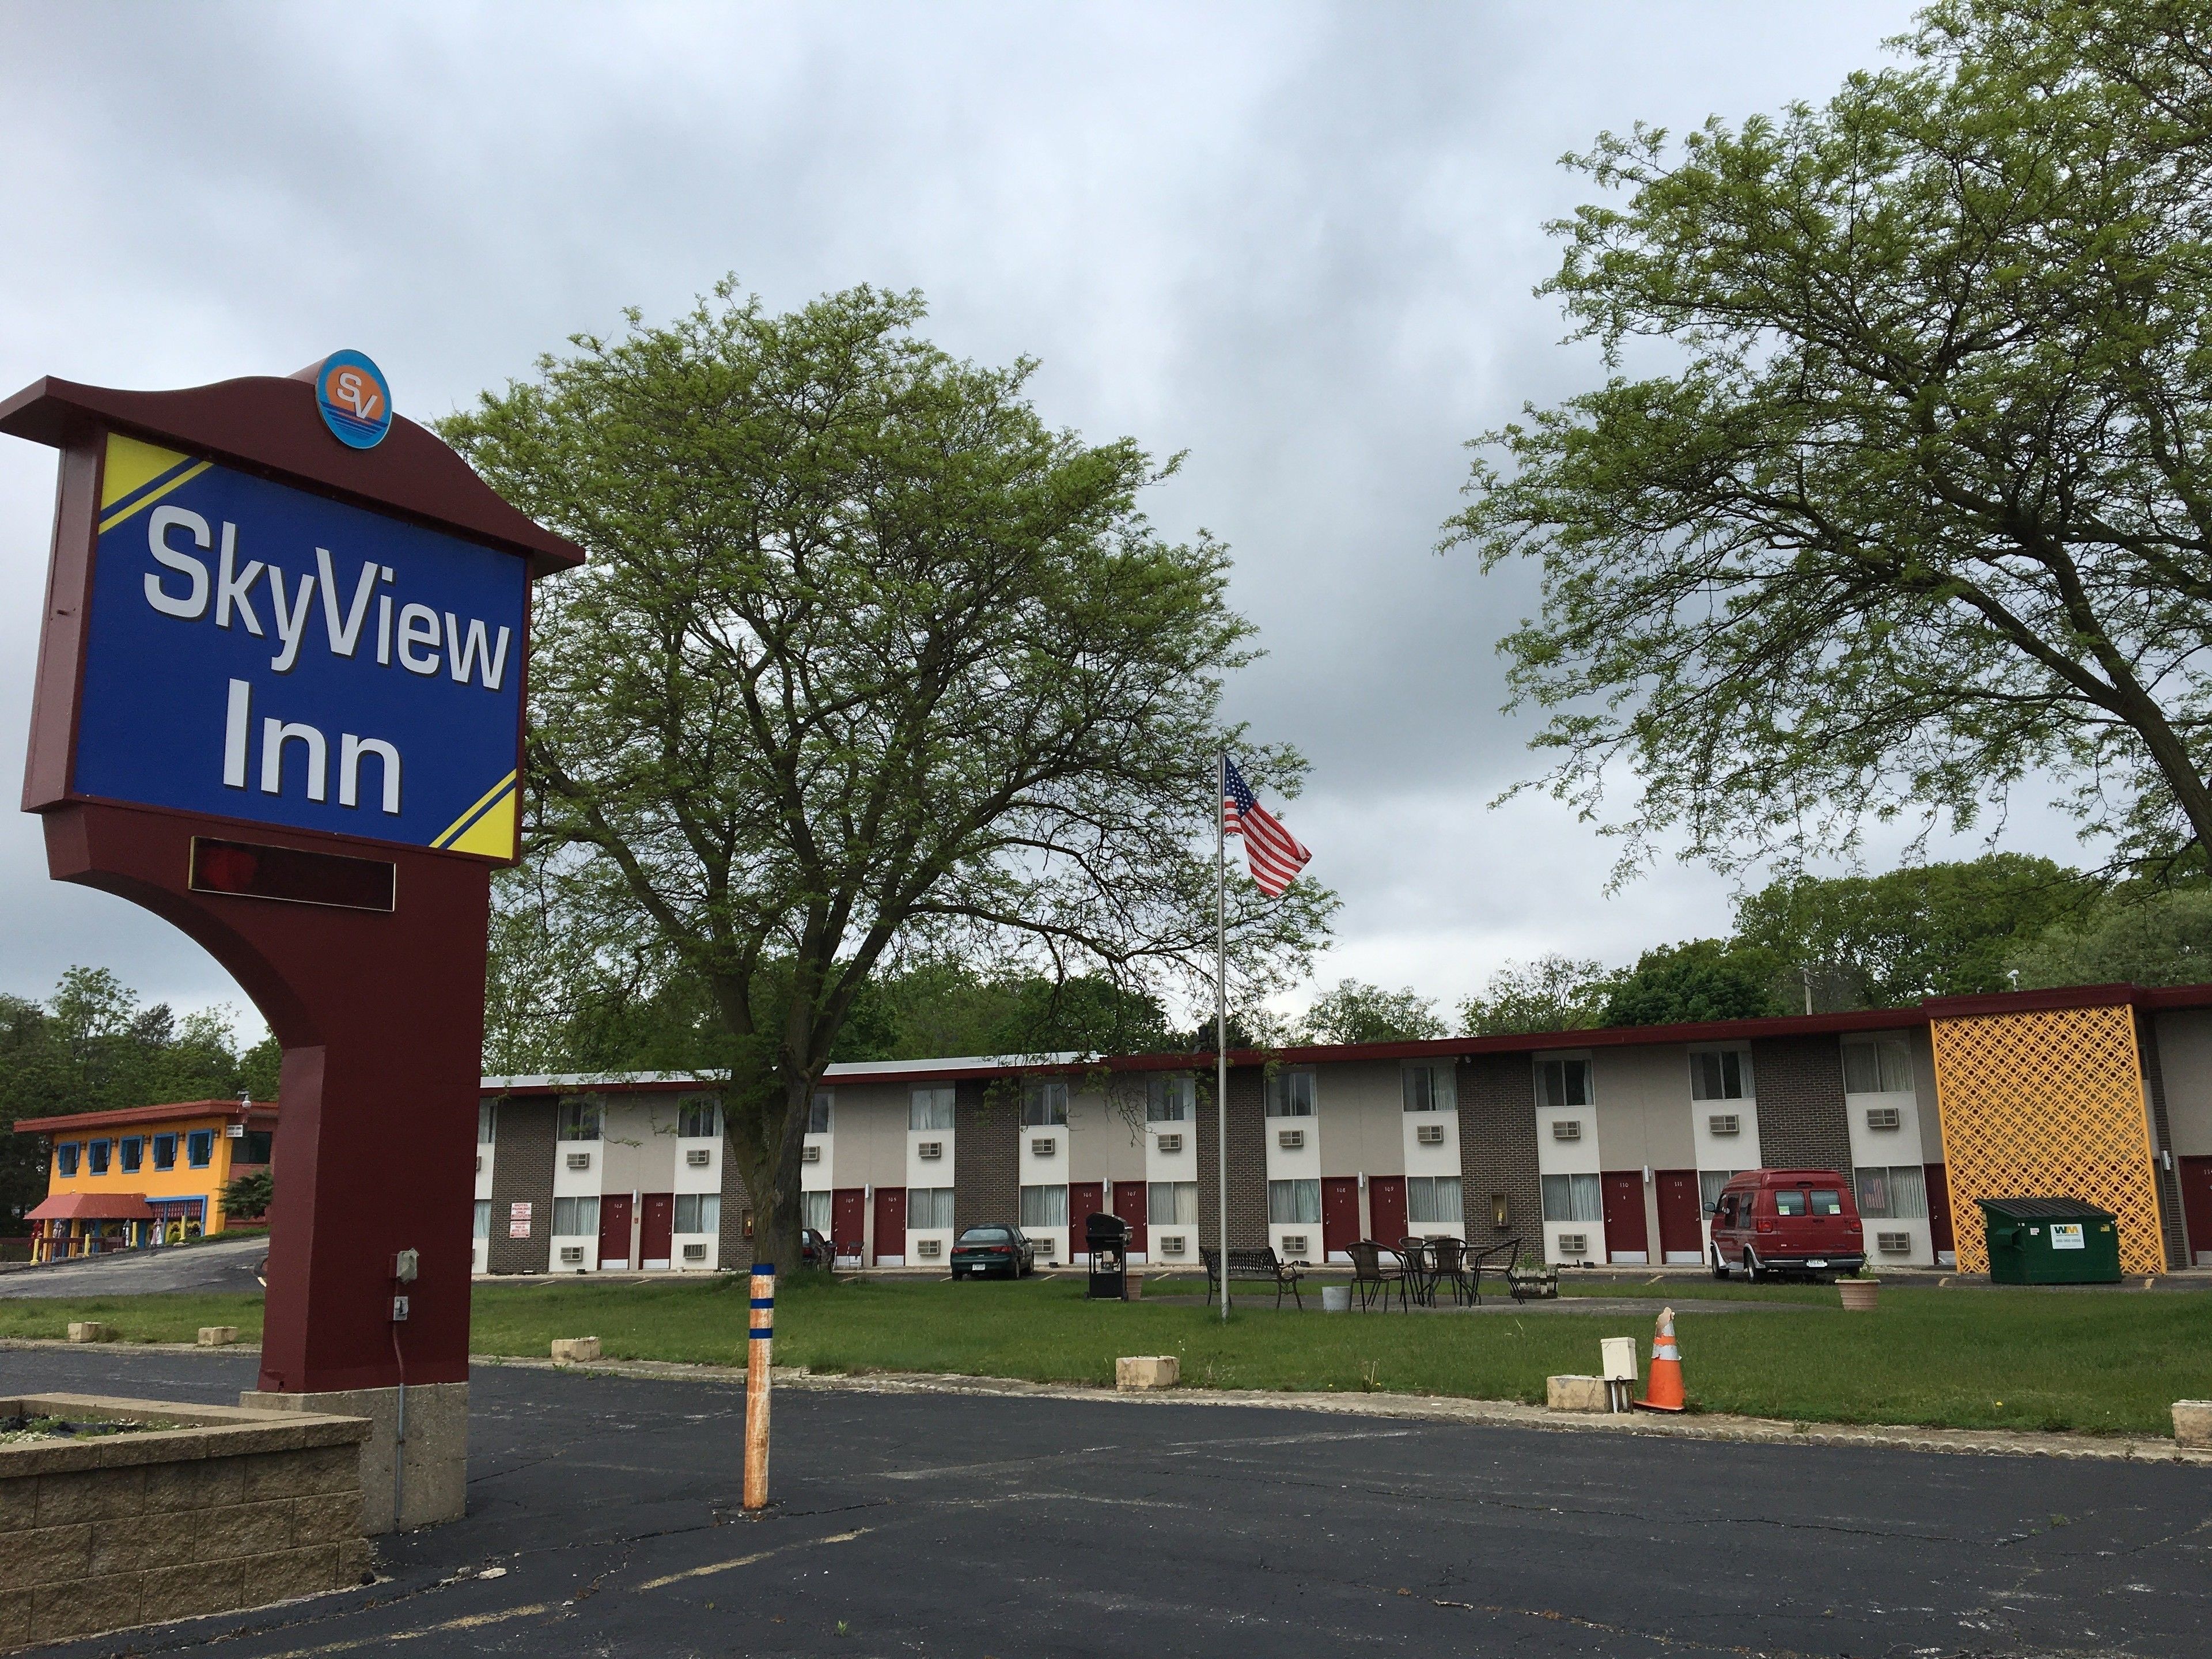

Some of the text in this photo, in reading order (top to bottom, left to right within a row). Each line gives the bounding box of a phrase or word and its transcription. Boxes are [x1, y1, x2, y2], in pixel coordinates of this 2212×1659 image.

[337, 372, 377, 420] SV
[143, 505, 510, 690] SkyView
[223, 679, 402, 814] Inn
[2054, 1226, 2078, 1234] WM
